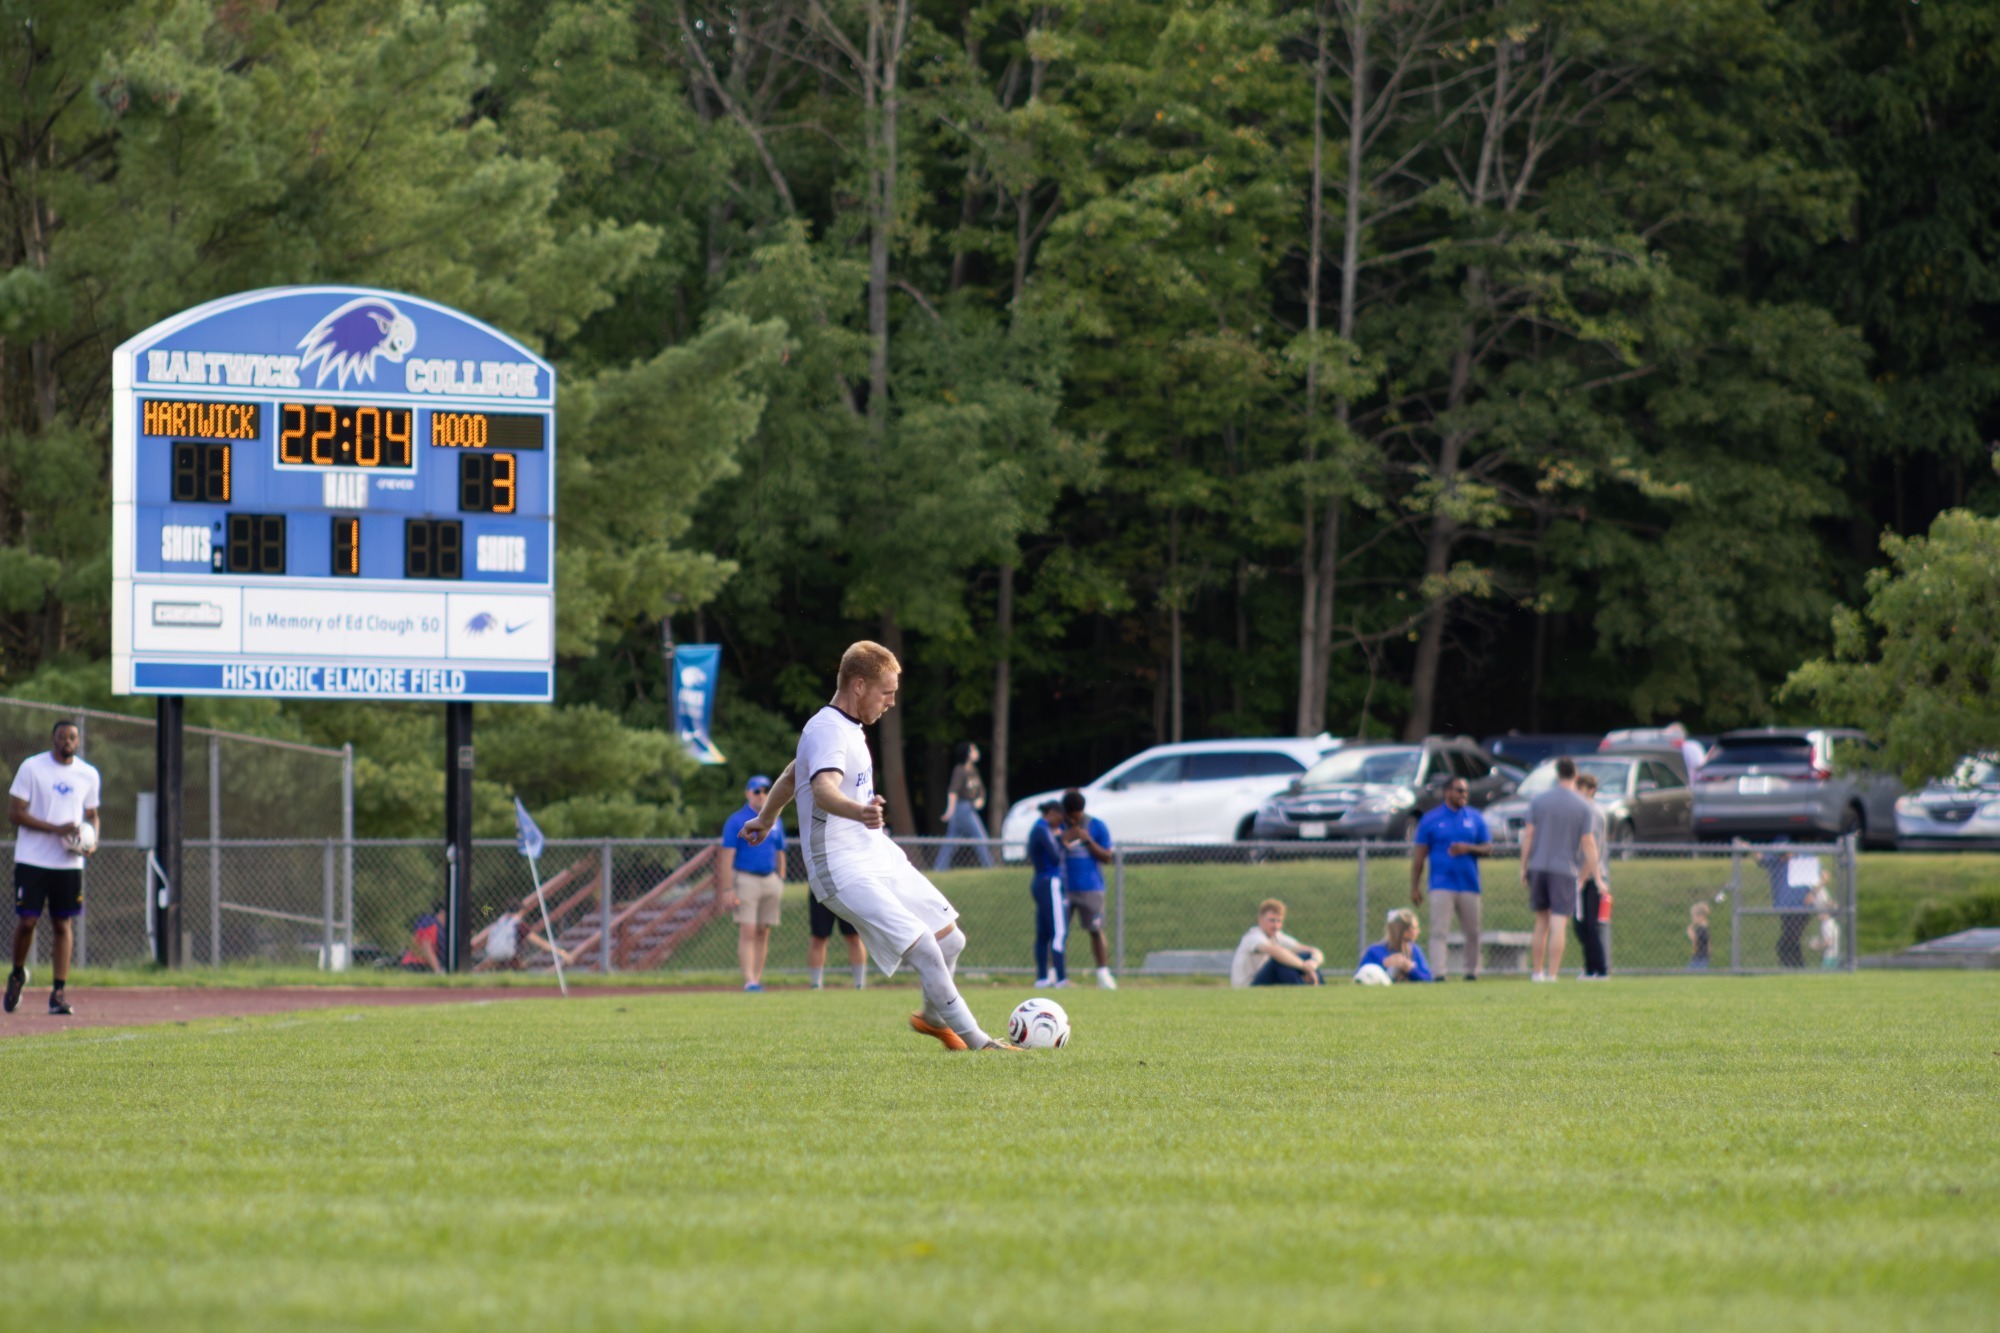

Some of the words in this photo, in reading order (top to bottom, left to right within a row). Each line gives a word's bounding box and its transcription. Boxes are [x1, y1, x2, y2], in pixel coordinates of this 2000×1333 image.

[148, 350, 300, 388] HARTWICK
[406, 358, 538, 397] COLLEGE
[143, 401, 255, 440] HARTWICK
[281, 403, 411, 467] 22:04
[432, 412, 488, 448] HOOD
[222, 445, 231, 501] 1
[324, 472, 368, 508] HALF
[492, 452, 516, 514] 3
[161, 525, 212, 563] SHOTS
[351, 519, 359, 574] 1
[249, 612, 262, 628] In
[266, 612, 322, 632] Memory
[327, 614, 341, 630] of
[346, 614, 363, 631] Ed
[367, 615, 414, 636] Clough
[221, 665, 320, 691] HISTORIC
[323, 667, 406, 693] ELMORE
[410, 670, 466, 694] FIELD
